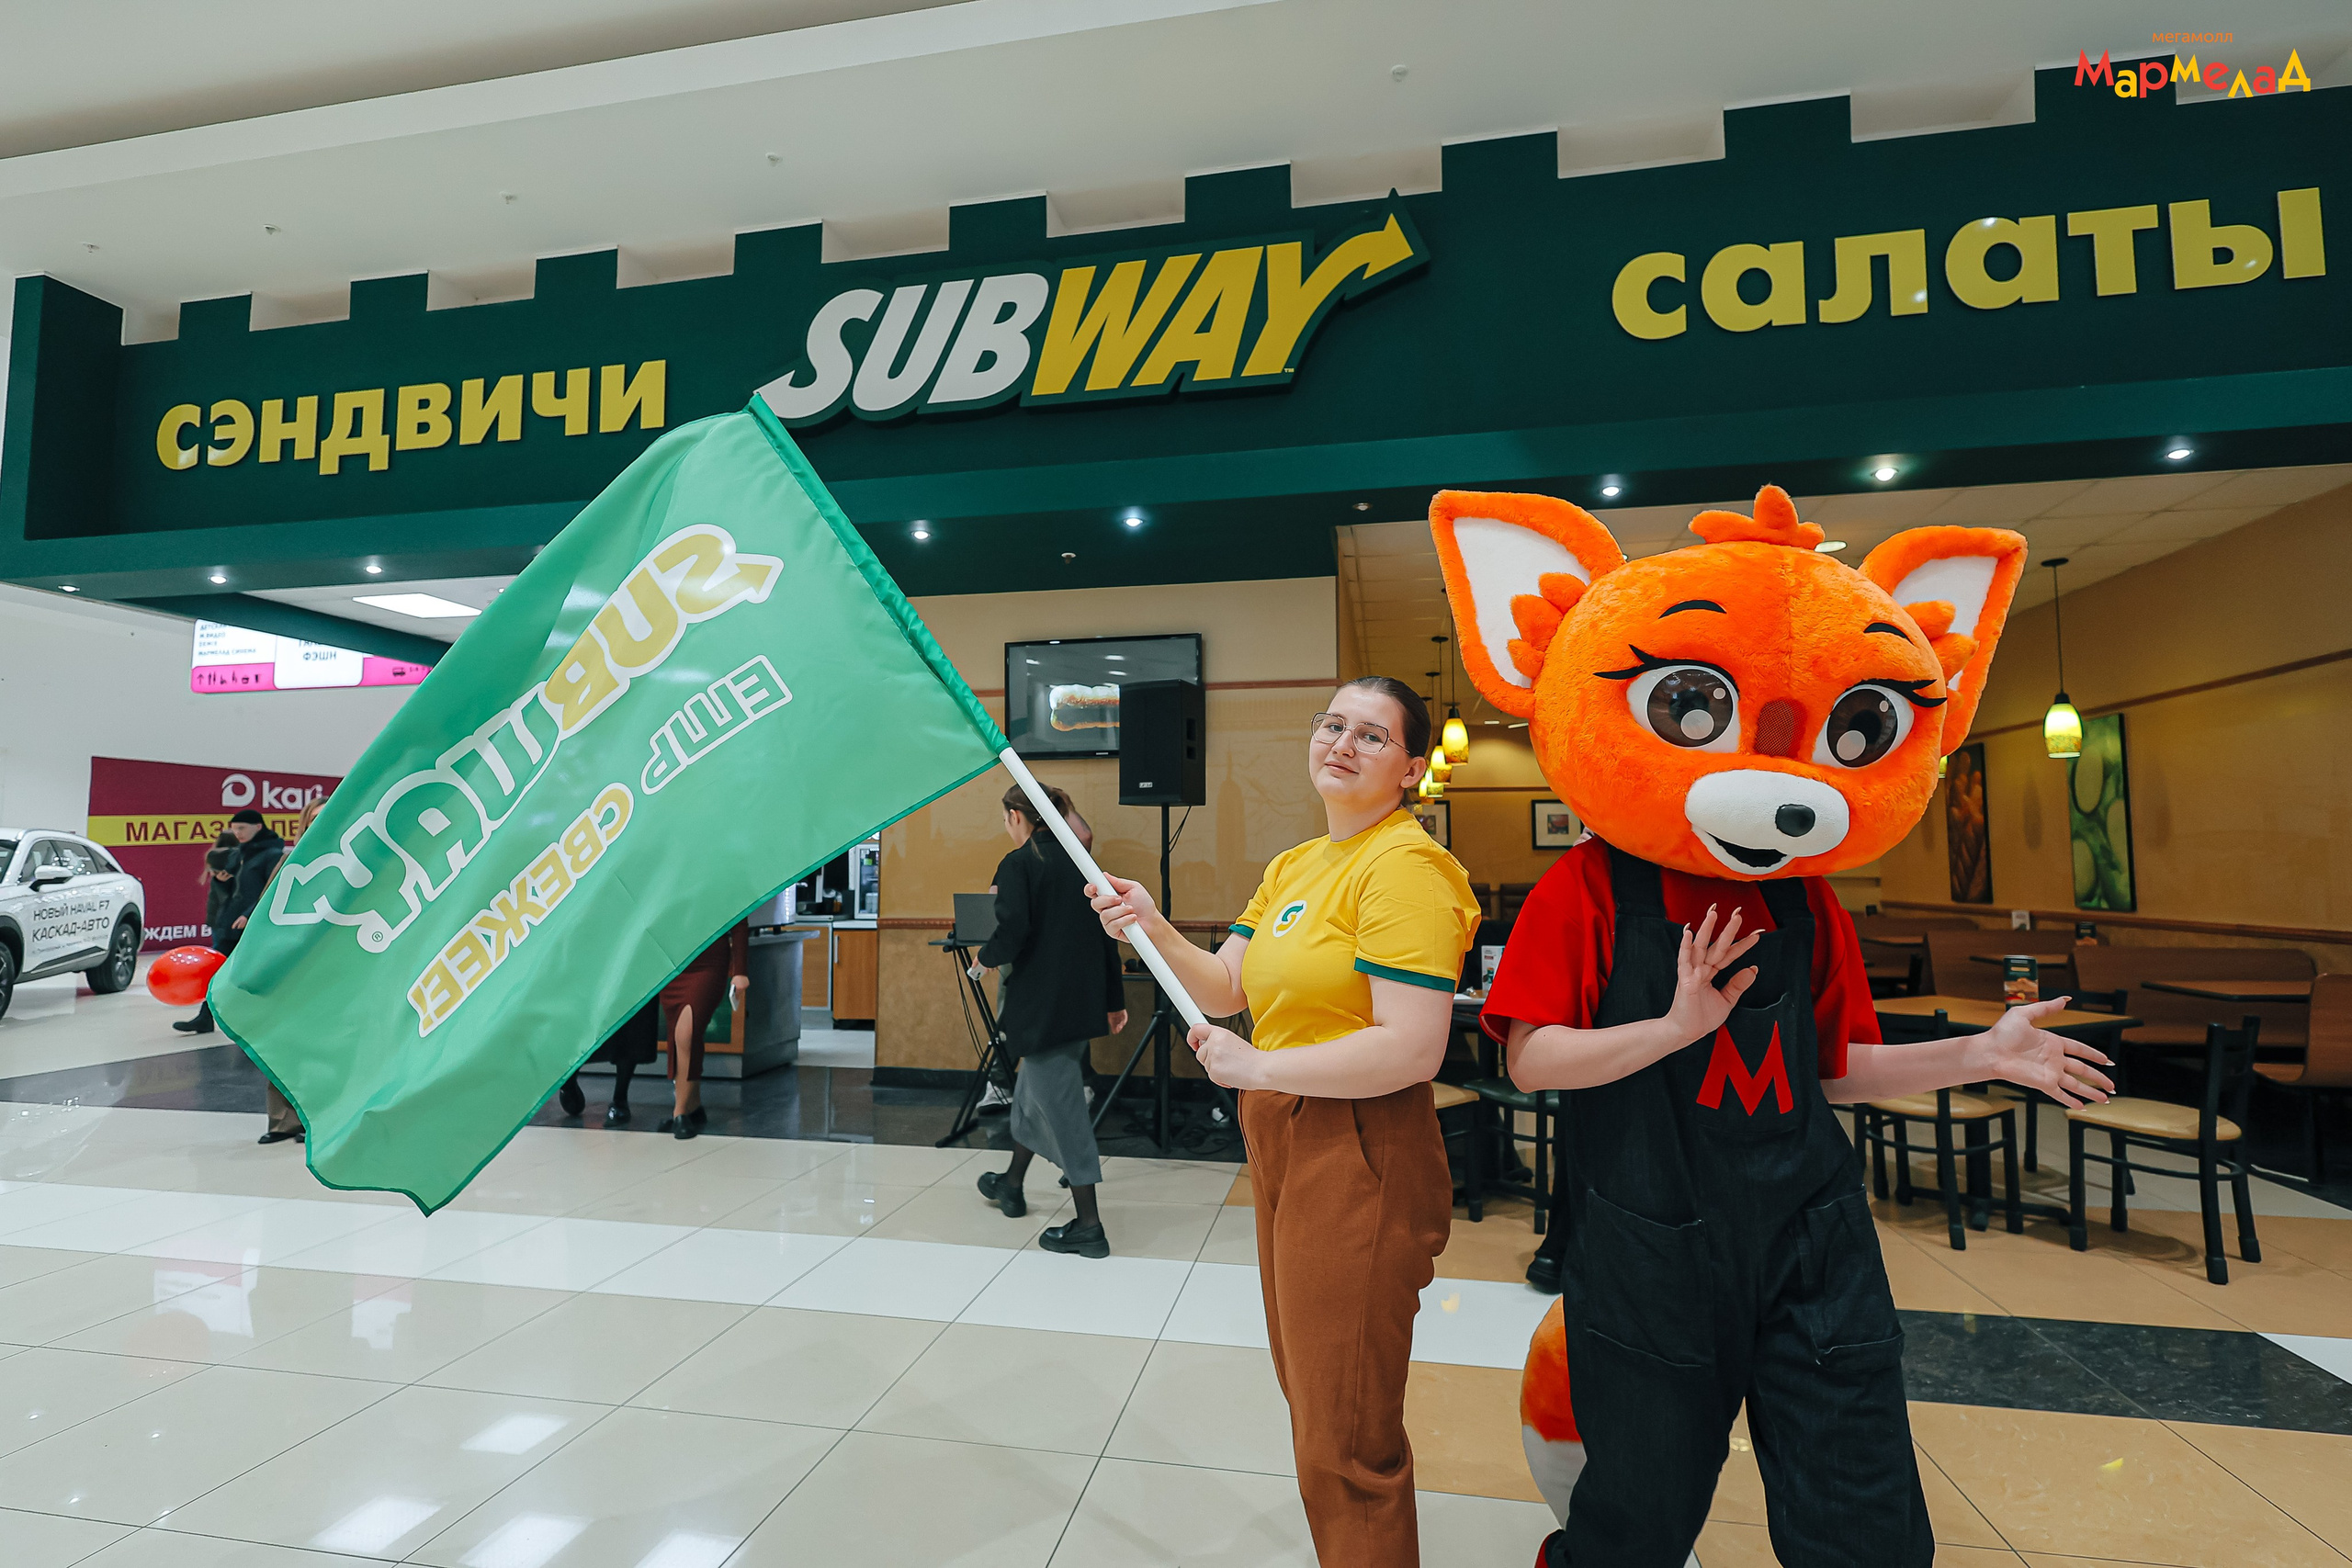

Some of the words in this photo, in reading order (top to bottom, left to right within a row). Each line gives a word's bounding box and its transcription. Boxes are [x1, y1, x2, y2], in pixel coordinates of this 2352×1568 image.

[755, 213, 1414, 419] SUBWAY
[303, 651, 336, 660] ФЭШН
[33, 903, 69, 921] НОВЫЙ
[70, 902, 96, 916] HAVAL
[98, 900, 110, 910] F7
[32, 917, 109, 942] КАСКАД-АВТО
